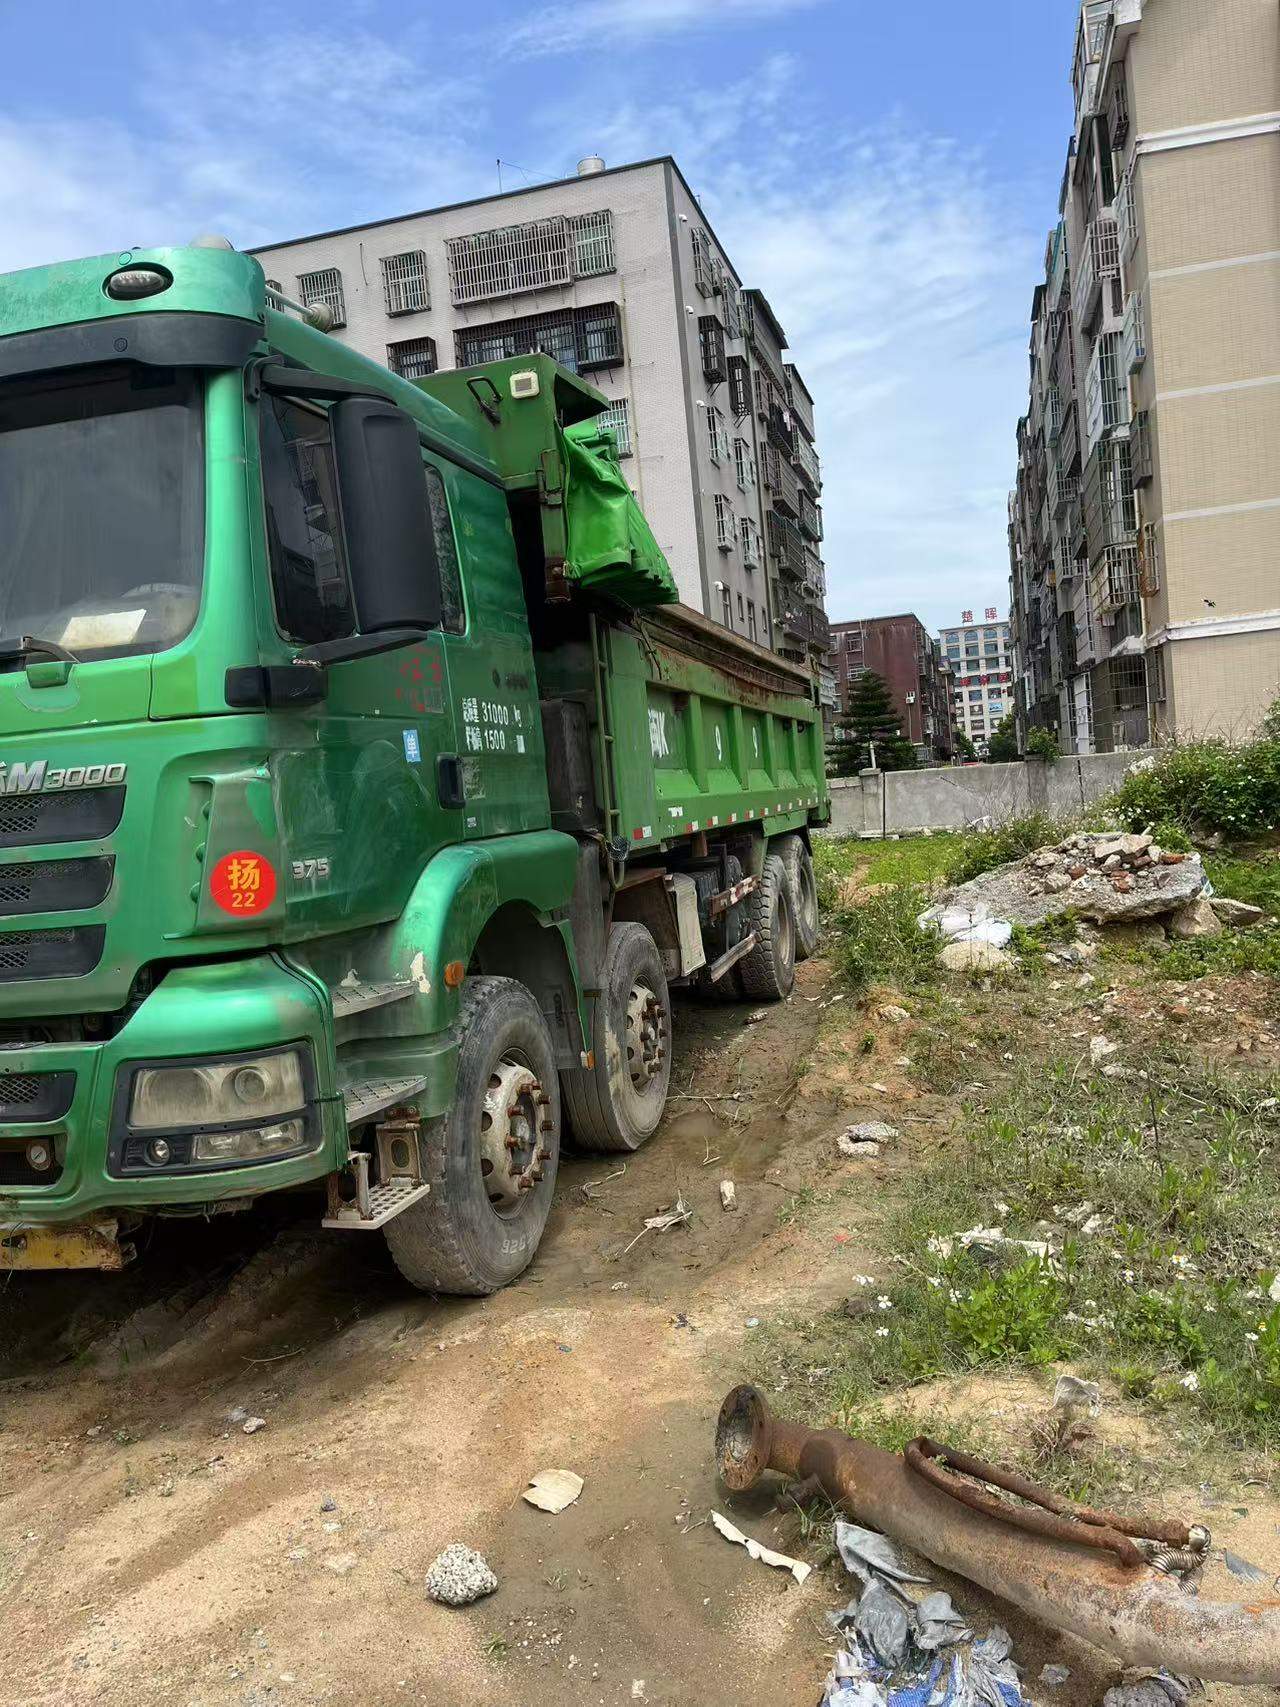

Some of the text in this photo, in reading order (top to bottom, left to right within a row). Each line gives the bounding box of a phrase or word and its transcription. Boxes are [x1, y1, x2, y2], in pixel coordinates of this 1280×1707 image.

[482, 702, 509, 725] 31000
[484, 730, 506, 750] 1500
[227, 858, 260, 891] 扬
[291, 859, 329, 880] 375
[231, 893, 256, 908] 22
